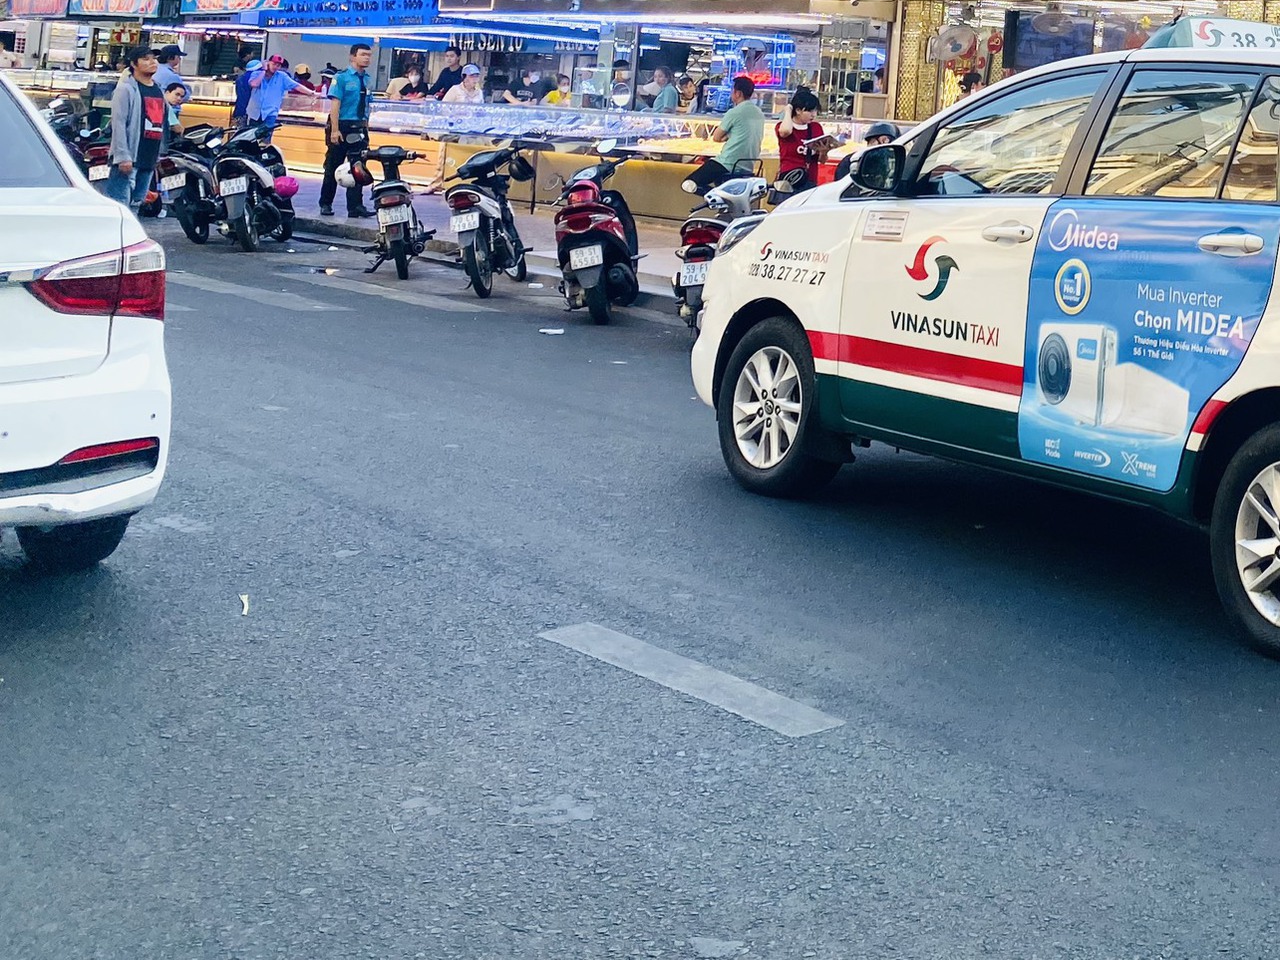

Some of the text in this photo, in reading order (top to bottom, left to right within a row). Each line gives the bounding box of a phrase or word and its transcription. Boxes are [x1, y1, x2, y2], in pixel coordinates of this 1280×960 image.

[1054, 215, 1119, 251] Midea
[809, 269, 826, 286] 27
[1137, 283, 1223, 309] Mua Inverter
[1134, 308, 1244, 339] Chọn MIDEA
